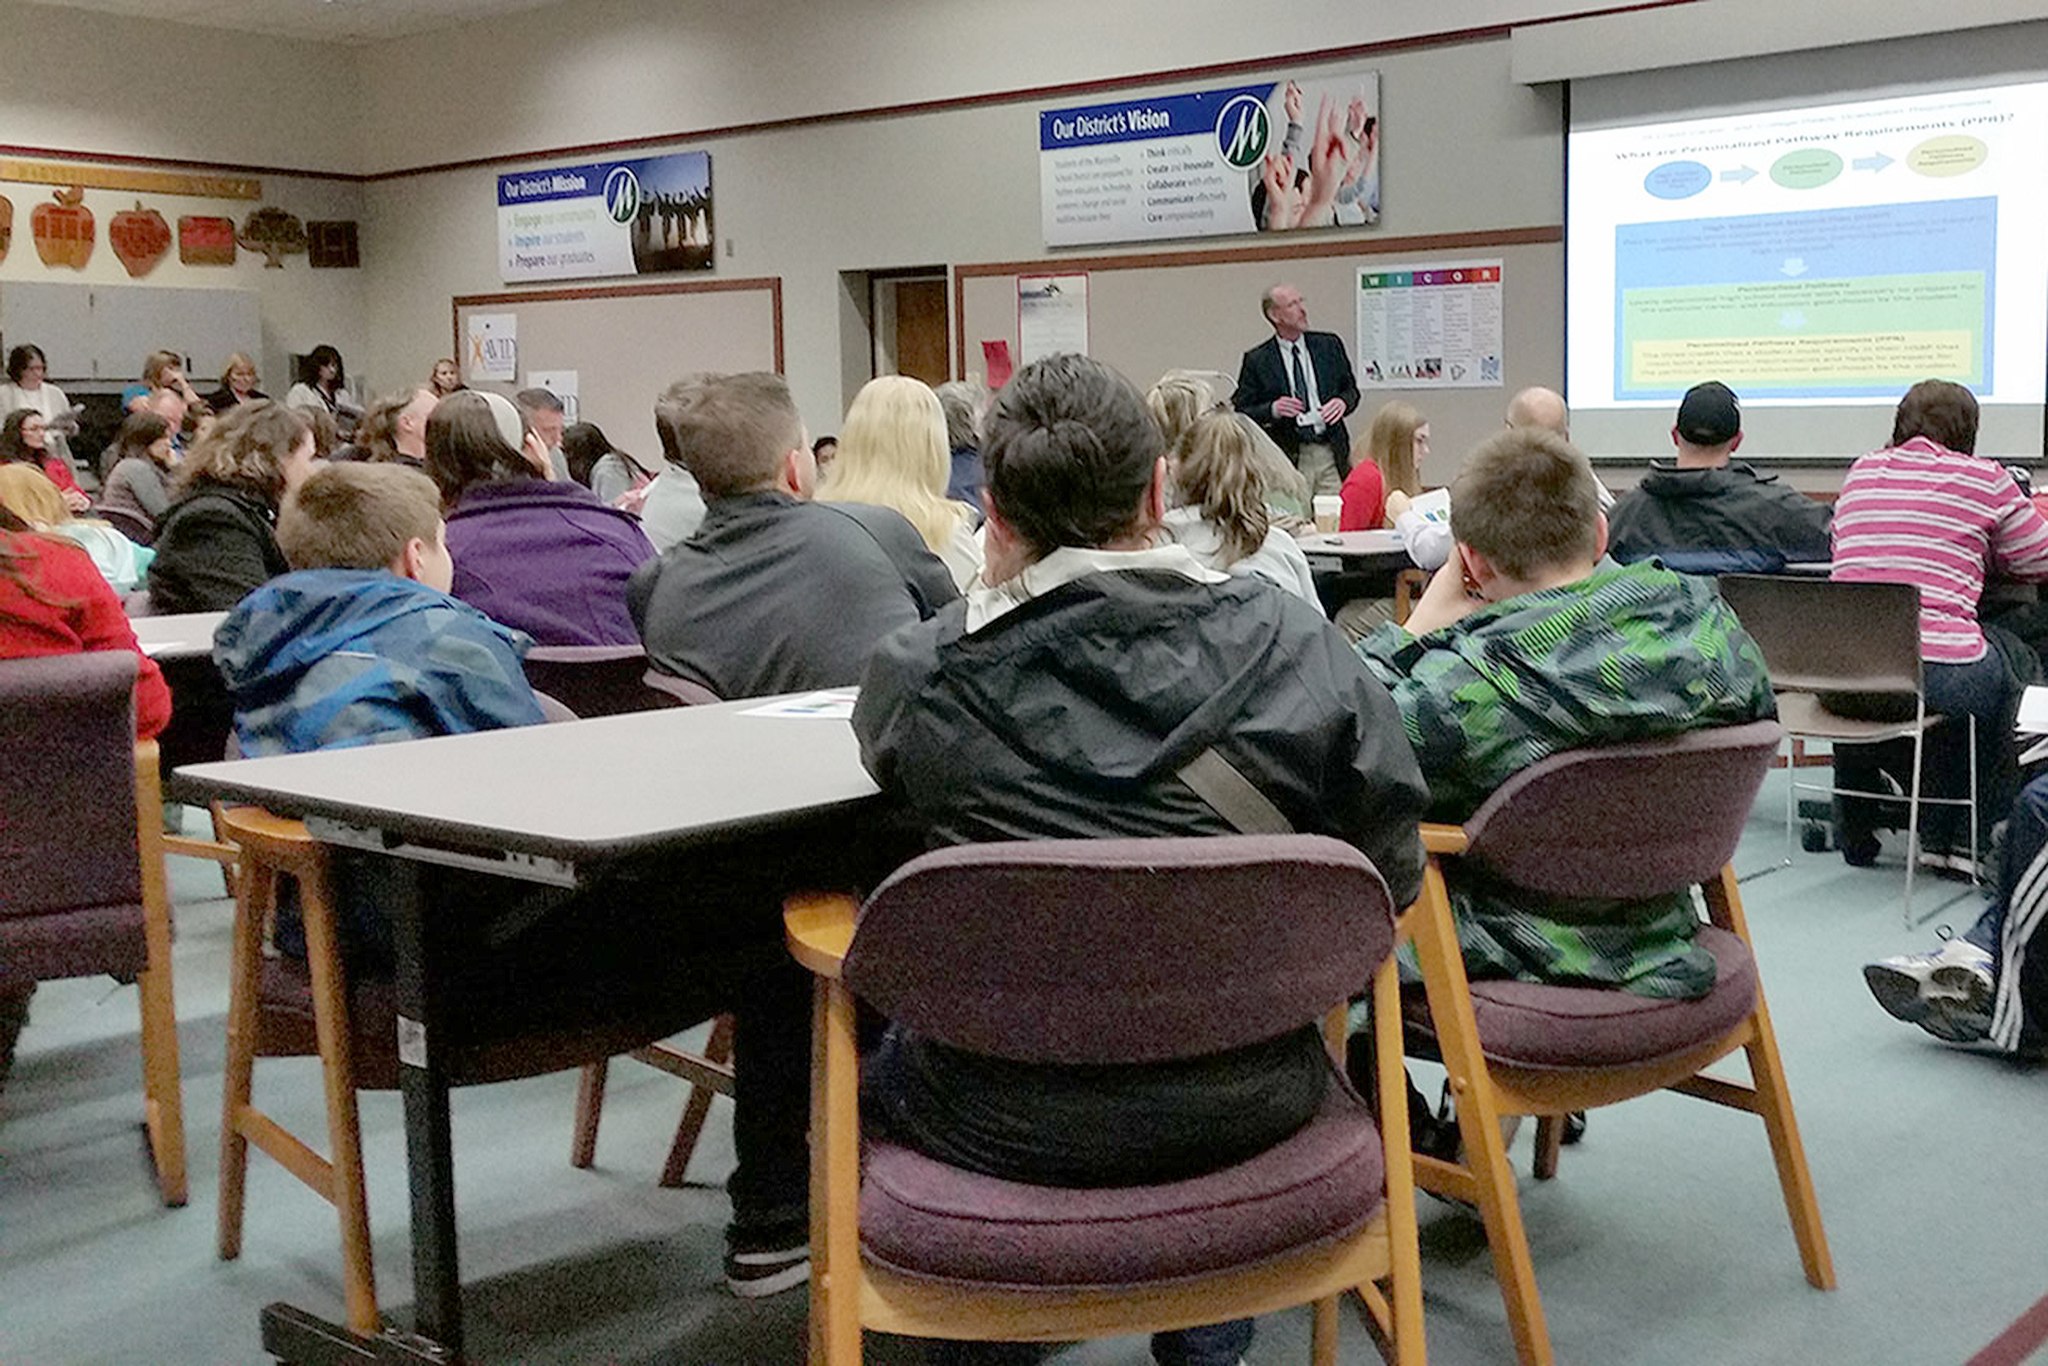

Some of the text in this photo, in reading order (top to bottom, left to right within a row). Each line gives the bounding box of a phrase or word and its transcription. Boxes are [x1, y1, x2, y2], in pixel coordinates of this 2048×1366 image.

[1053, 108, 1170, 139] Our District's Vision
[1615, 151, 1651, 160] What
[1656, 149, 1677, 157] are
[1681, 138, 1772, 153] Personalized
[1776, 133, 1839, 144] Pathway
[1844, 121, 1956, 137] Requirements
[1146, 164, 1169, 175] Create
[1146, 179, 1187, 191] Collaborate
[1146, 195, 1194, 207] Communicate
[1146, 211, 1163, 223] Care
[1368, 276, 1381, 286] W
[1481, 269, 1492, 280] R
